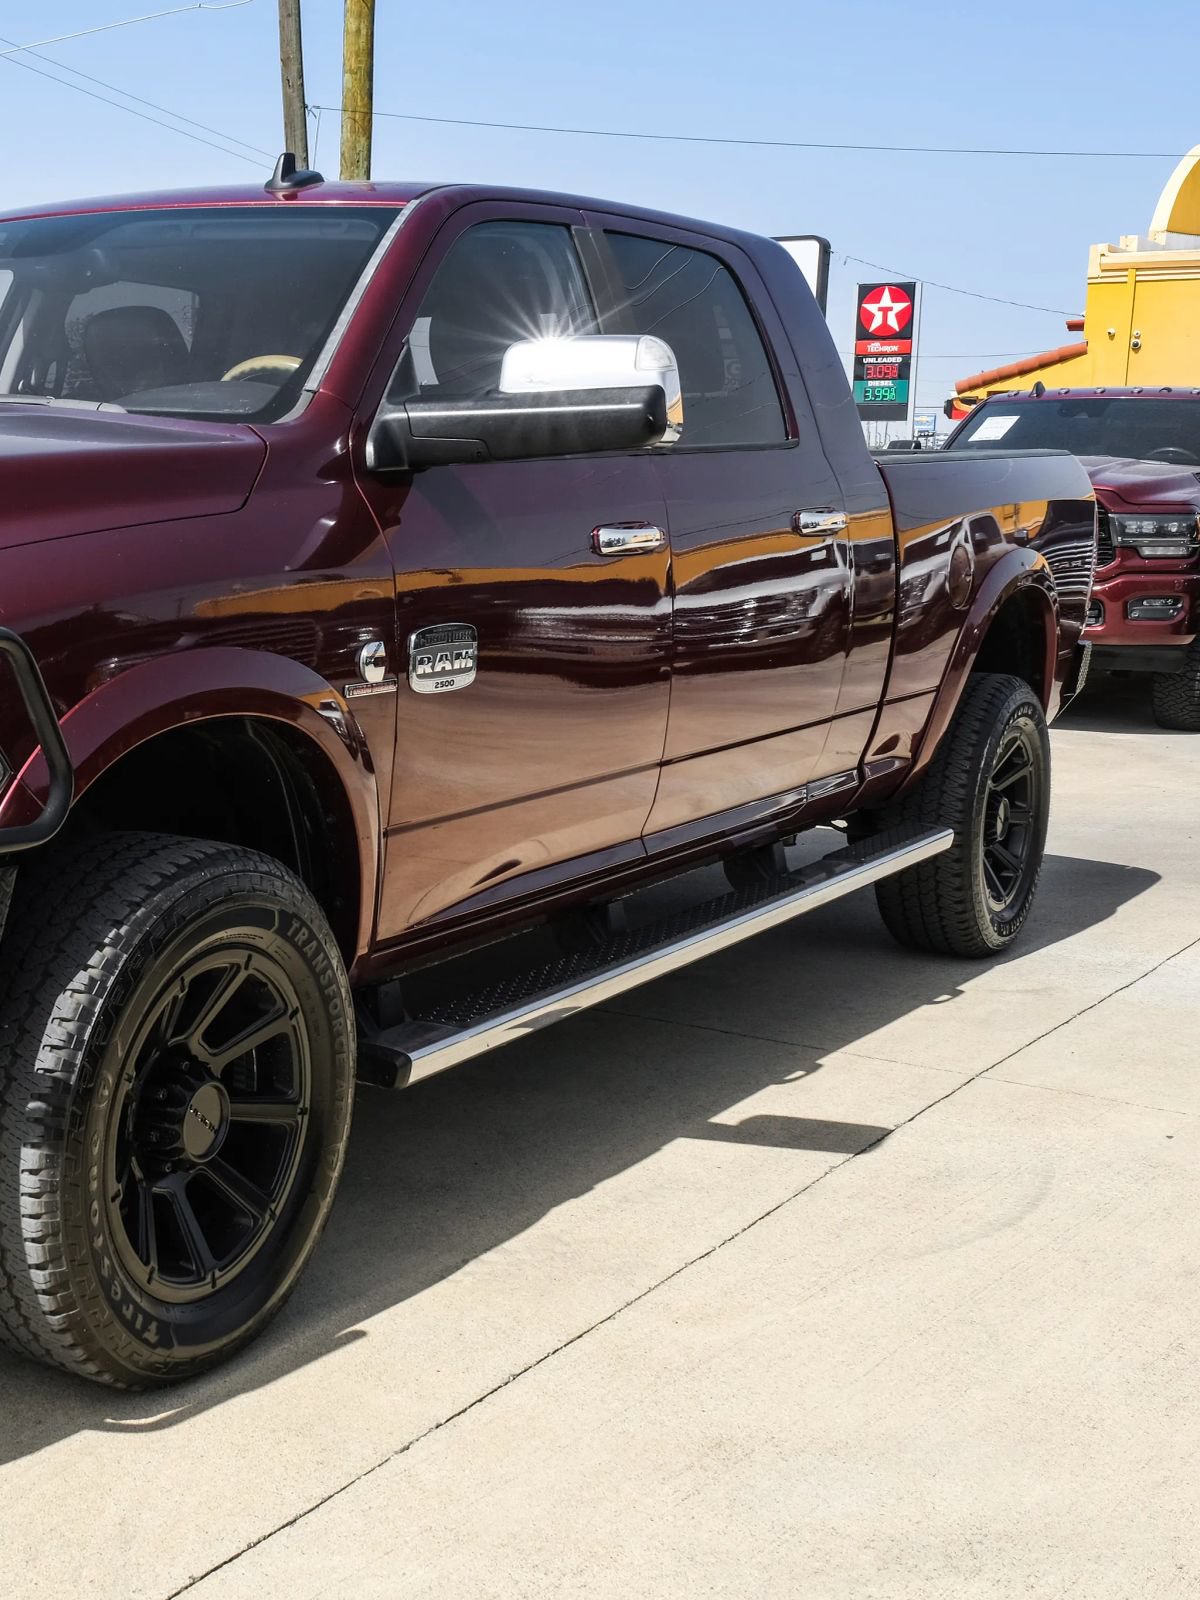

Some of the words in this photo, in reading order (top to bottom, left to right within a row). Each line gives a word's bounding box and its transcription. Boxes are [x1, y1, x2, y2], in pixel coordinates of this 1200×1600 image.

[416, 650, 473, 674] RAM
[434, 680, 455, 689] 2500
[286, 918, 348, 1070] TRANSFORCE
